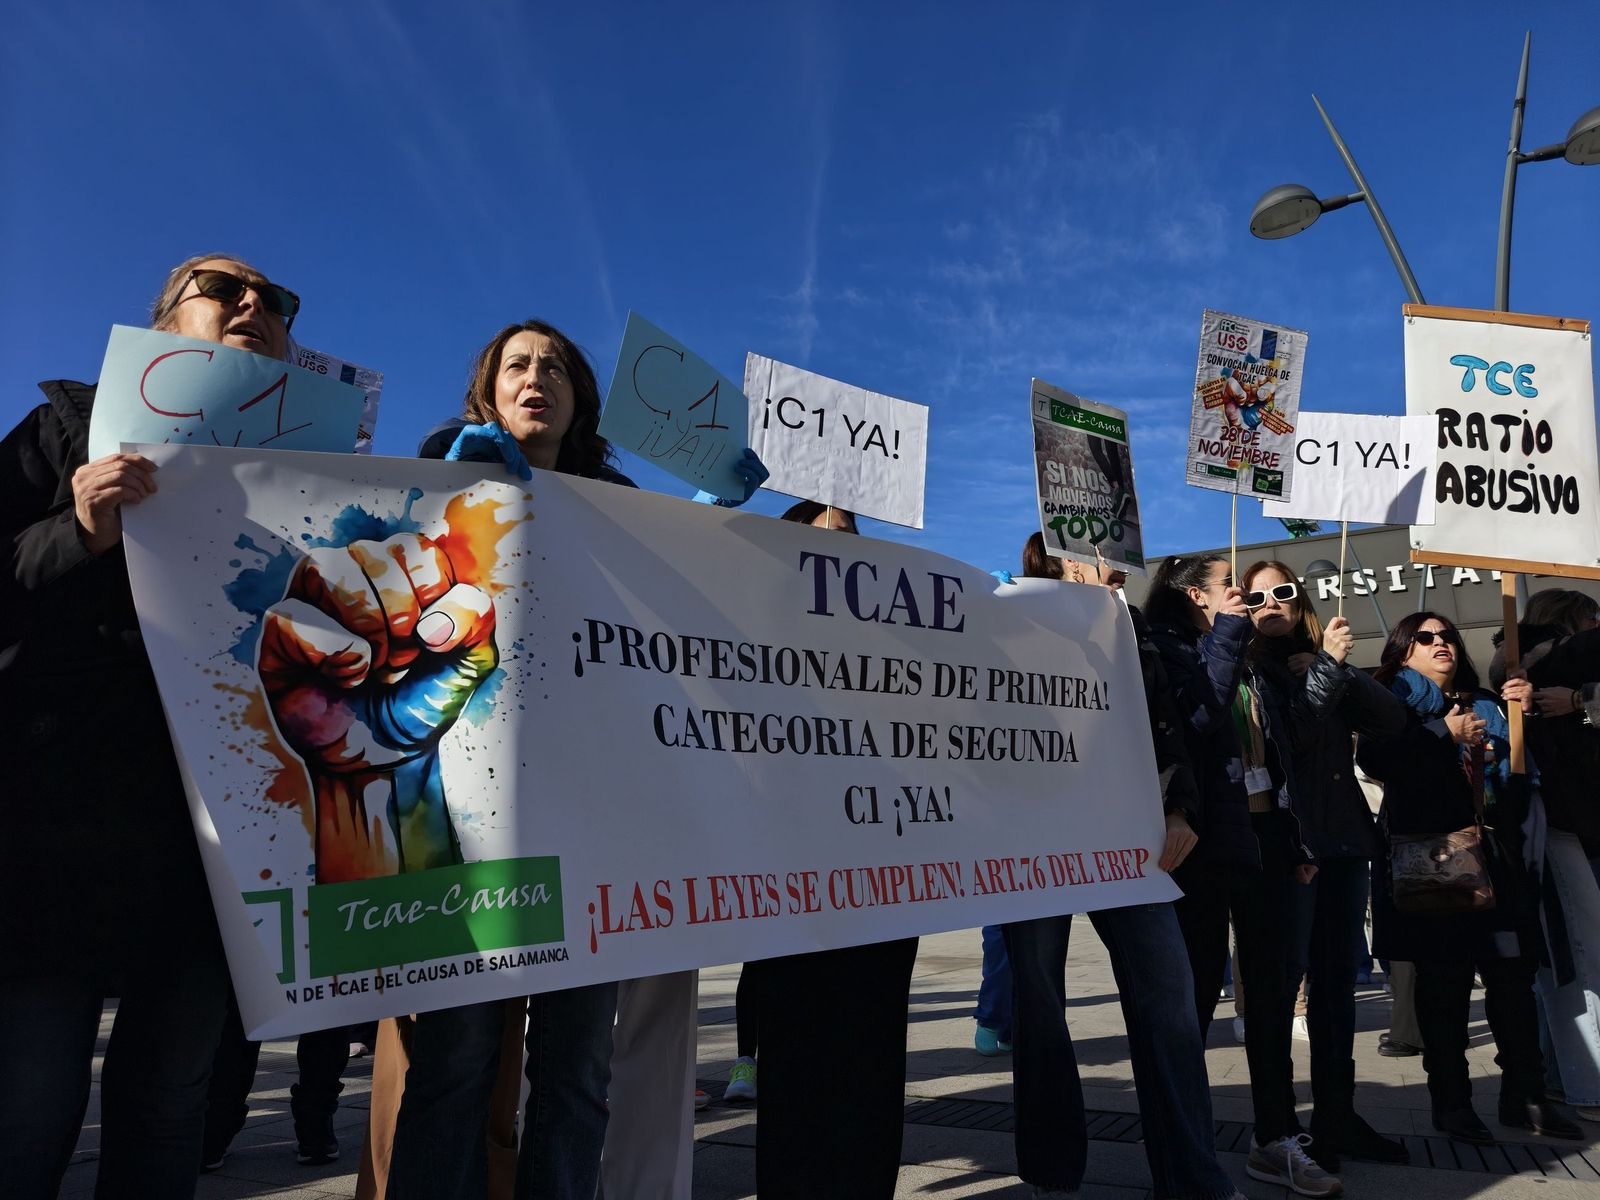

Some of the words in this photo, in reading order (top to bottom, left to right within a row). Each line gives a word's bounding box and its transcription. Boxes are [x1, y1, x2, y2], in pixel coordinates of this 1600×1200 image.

[1217, 332, 1248, 351] USO
[1207, 354, 1248, 372] CONVOCAN
[1250, 363, 1278, 378] HUELGA
[1280, 370, 1291, 381] DE
[1238, 372, 1257, 384] TCAE
[1450, 354, 1539, 398] TCE
[633, 345, 729, 431] C1
[762, 396, 826, 437] ¡C1
[842, 414, 901, 460] YA!
[1052, 404, 1122, 434] TCAE-Causa
[1220, 426, 1237, 442] 28
[1241, 431, 1262, 446] DE
[1198, 439, 1280, 468] NOVIEMBRE
[1355, 441, 1410, 470] YA!
[1046, 460, 1067, 485] SI
[1072, 466, 1111, 494] NOS
[1043, 501, 1111, 520] CAMBIAMOS
[1049, 484, 1113, 510] MOVEMOS
[1047, 515, 1125, 550] TODO
[800, 551, 966, 633] TCAE
[571, 618, 922, 697] ¡PROFESIONALES
[932, 662, 978, 702] DE
[986, 668, 1110, 711] PRIMERA!
[653, 703, 879, 758] CATEGORIA
[890, 721, 938, 760] DE
[947, 725, 1079, 763] SEGUNDA
[844, 785, 883, 824] C1
[893, 785, 953, 837] ¡YA!
[337, 883, 552, 932] Tcae-Causa
[588, 879, 674, 954] ¡LAS
[682, 873, 781, 925] LEYES
[785, 871, 823, 915] SE
[828, 861, 963, 912] CUMPLEN!
[1052, 853, 1095, 887] DEL
[1099, 847, 1149, 881] EBEP
[303, 985, 324, 1003] DE
[329, 977, 369, 998] TCAE
[374, 973, 403, 991] DEL
[407, 963, 459, 985] CAUSA
[464, 958, 485, 975] DE
[489, 947, 569, 971] SALAMANCA
